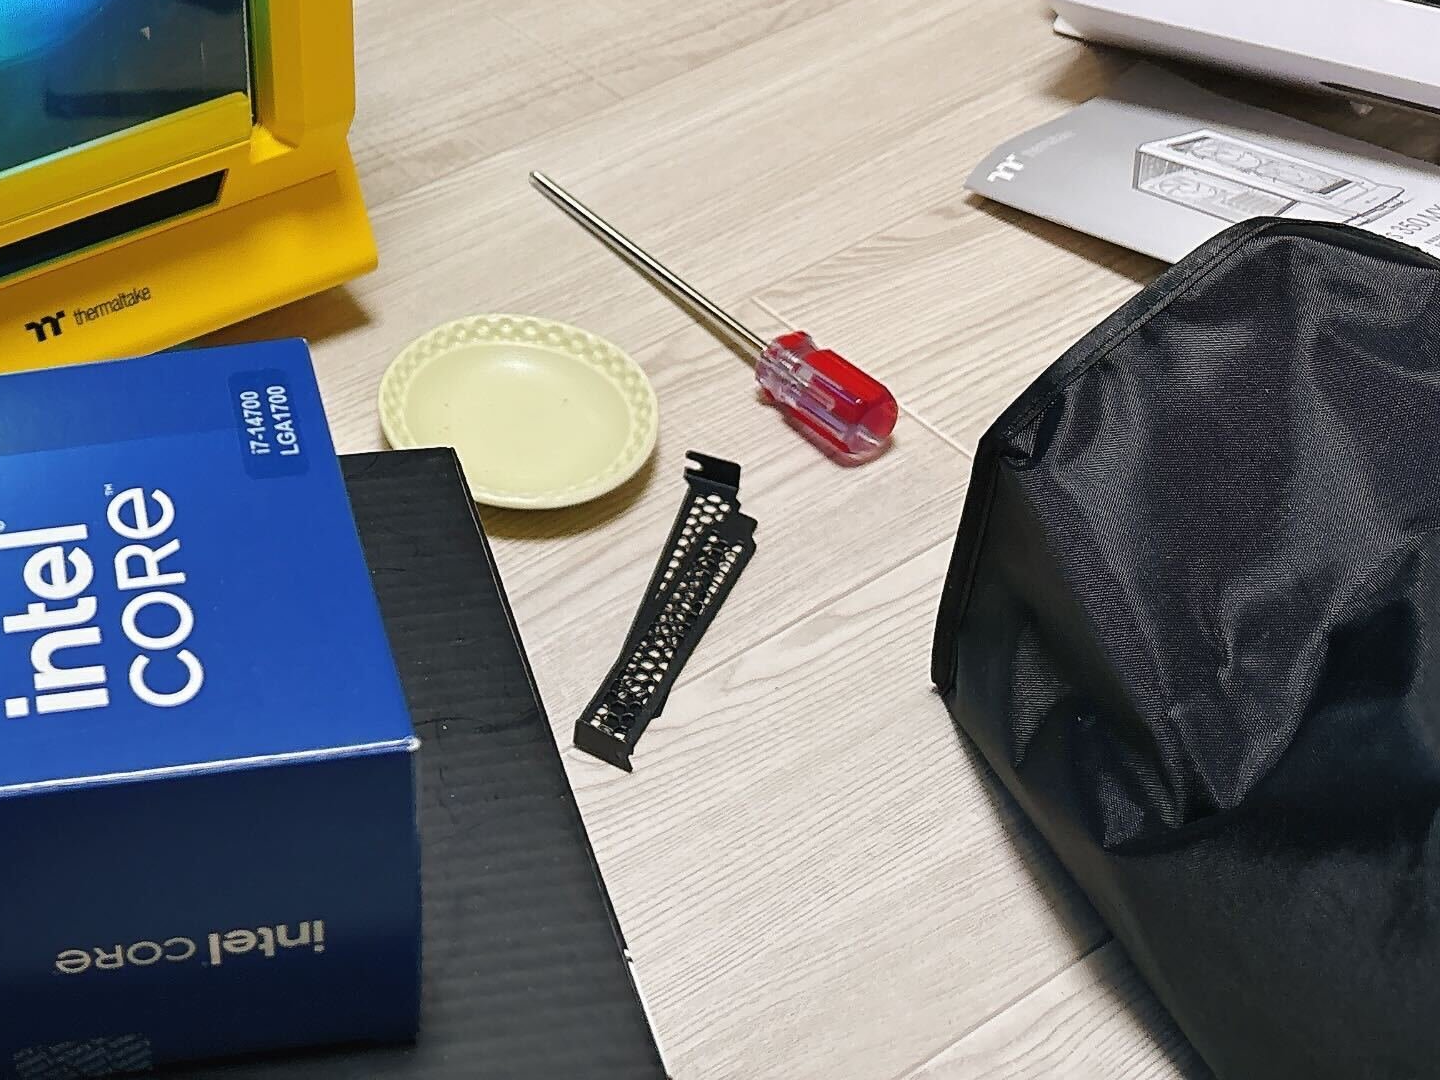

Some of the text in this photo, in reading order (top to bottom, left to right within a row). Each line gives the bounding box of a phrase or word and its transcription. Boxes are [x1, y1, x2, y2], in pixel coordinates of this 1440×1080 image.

[73, 287, 152, 325] thermaltake
[240, 391, 271, 455] i7-14700
[266, 385, 300, 456] LGA1700
[207, 919, 325, 967] intel
